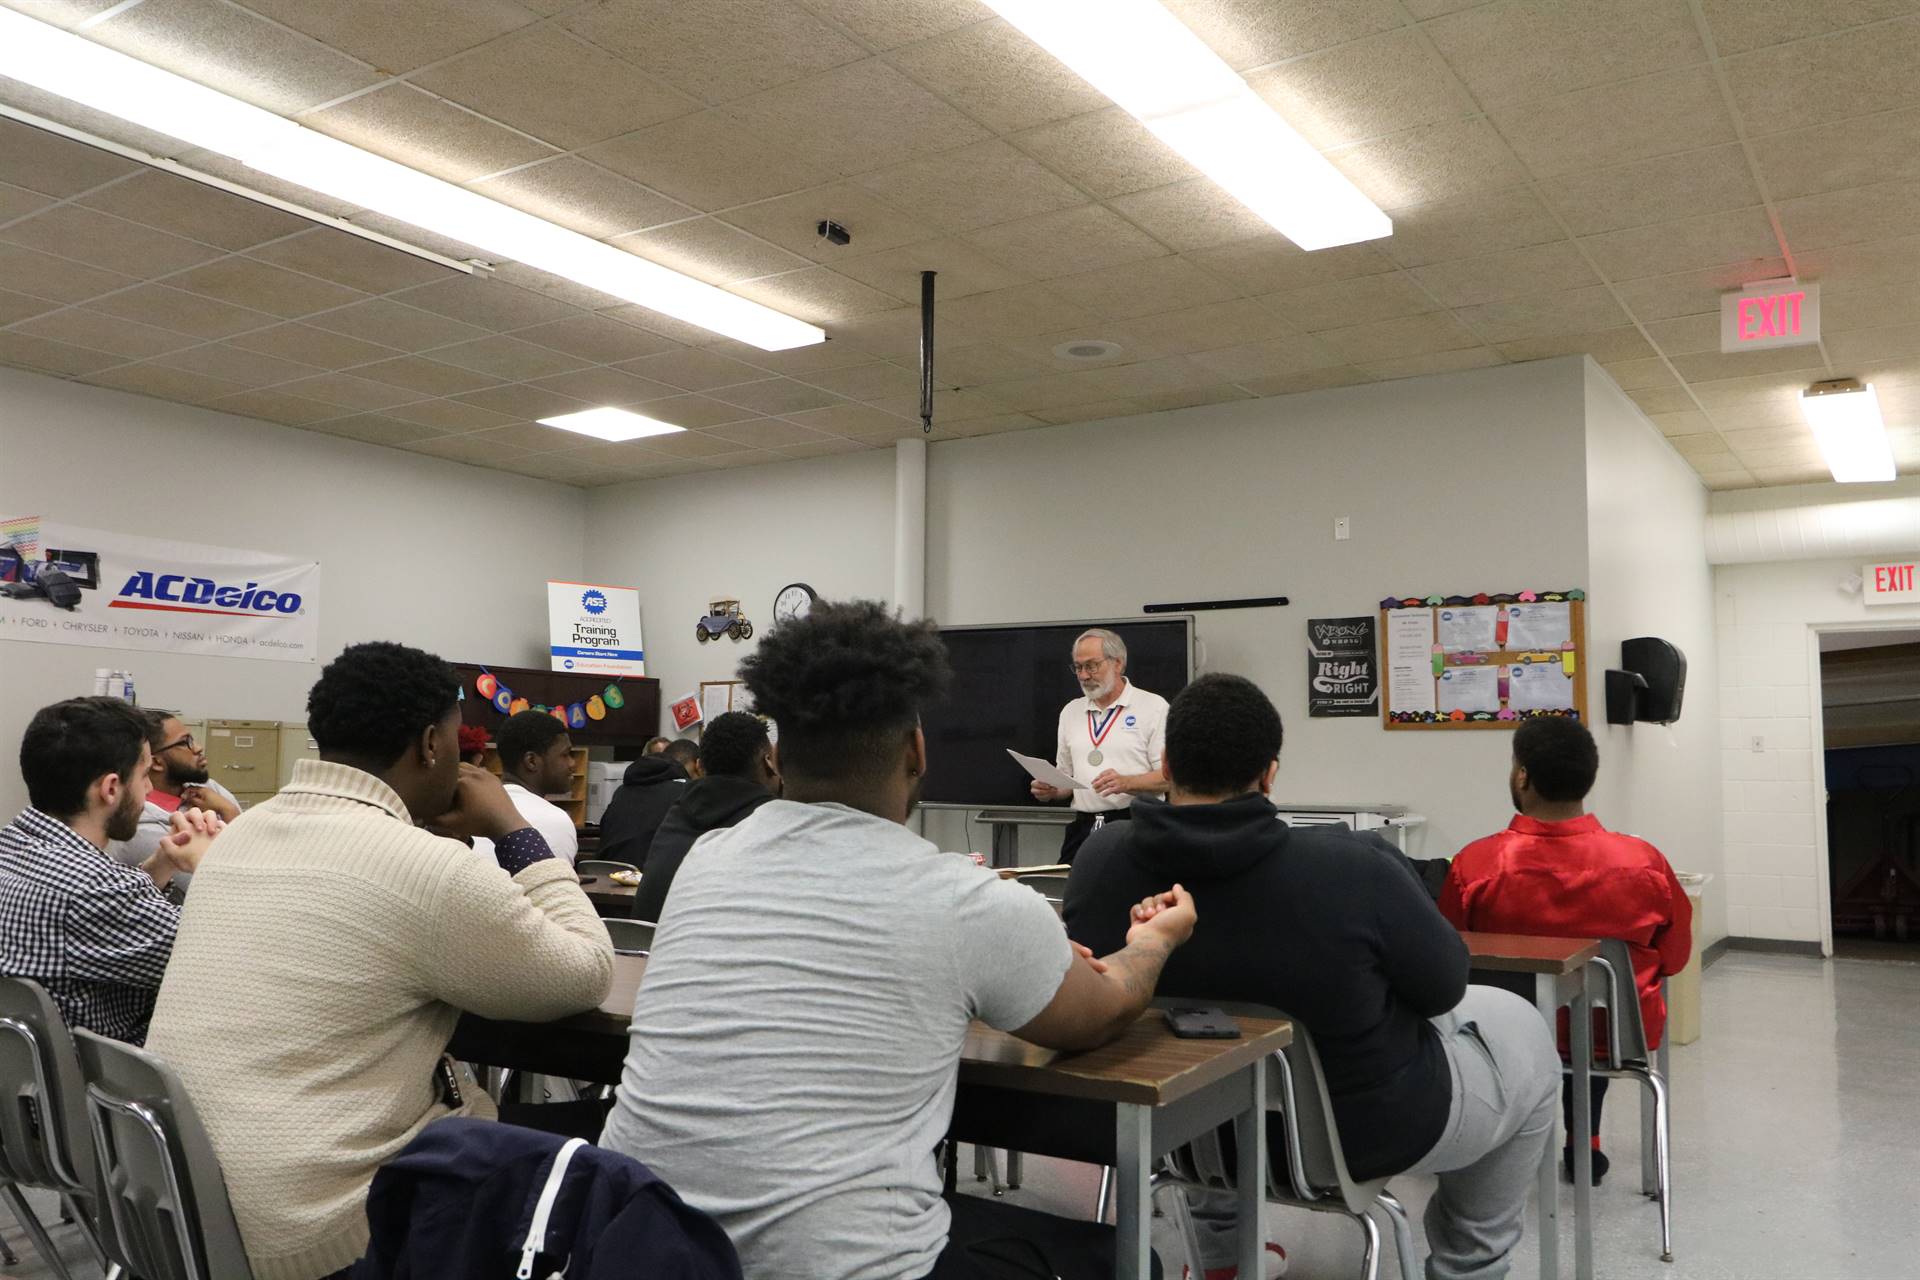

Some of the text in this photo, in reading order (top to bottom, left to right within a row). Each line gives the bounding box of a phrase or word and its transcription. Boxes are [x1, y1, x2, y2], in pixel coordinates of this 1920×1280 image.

[1737, 291, 1805, 341] EXIT
[1875, 565, 1914, 592] EXIT
[118, 571, 302, 614] ACDelco
[585, 597, 604, 606] ASE
[21, 617, 304, 650] FORD CHRYSLER TOYOTA NISSAN HONDA acdelco.com
[574, 623, 616, 638] Training
[572, 634, 619, 647] Program
[1318, 661, 1368, 679] Right
[1333, 682, 1369, 694] RIGHT
